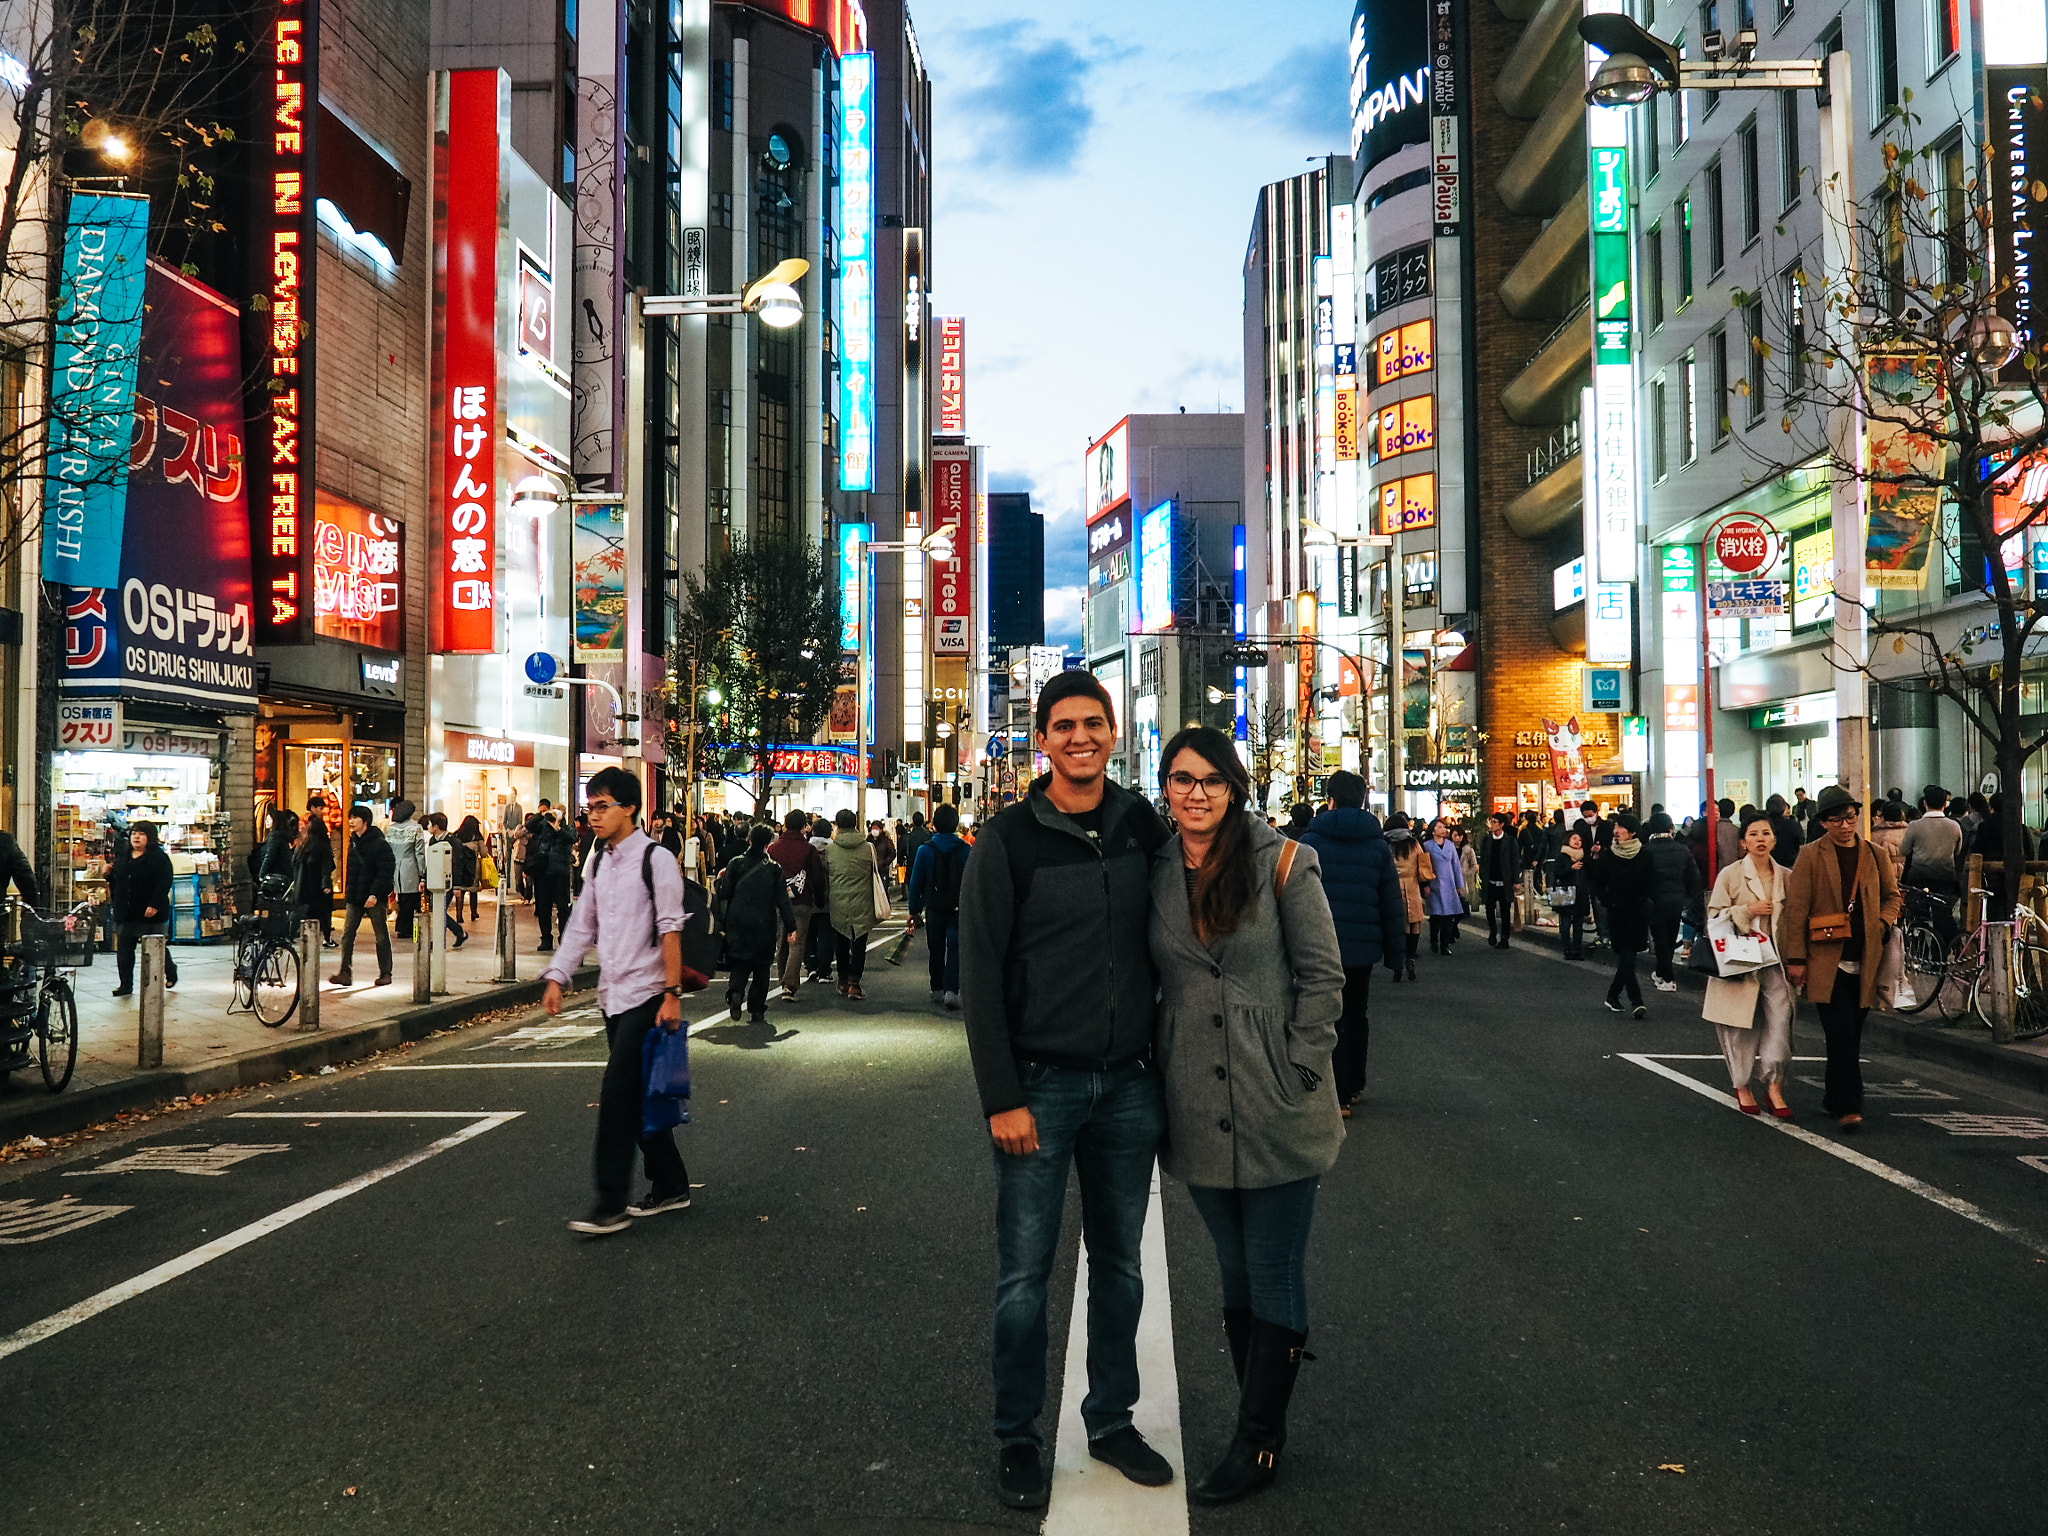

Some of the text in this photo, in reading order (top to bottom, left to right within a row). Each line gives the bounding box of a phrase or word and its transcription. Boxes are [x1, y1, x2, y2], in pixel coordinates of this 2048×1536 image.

[1434, 70, 1445, 103] MARU
[1444, 70, 1455, 102] NIJYU
[2007, 85, 2029, 223] UNIVERSAL
[1435, 175, 1458, 221] Pausa
[686, 230, 700, 297] 眼鏡市場
[55, 228, 107, 562] DIAMOND SHIRAISHI
[99, 342, 126, 451] GINZA
[272, 388, 298, 463] TAX
[452, 385, 488, 611] ほけんの窓口
[949, 462, 962, 511] QUICK
[272, 473, 298, 556] FREE
[1736, 527, 1758, 535] HYDRANT
[1109, 549, 1130, 583] ALTA
[1720, 536, 1764, 557] 消火栓
[941, 557, 962, 613] Free
[1727, 581, 1781, 599] セキネ
[940, 637, 965, 647] VISA
[125, 646, 252, 690] OS DRUG SHINJUKU
[61, 706, 113, 721] OS新宿店
[62, 722, 113, 745] クスリ
[1409, 768, 1478, 786] COMPANY
